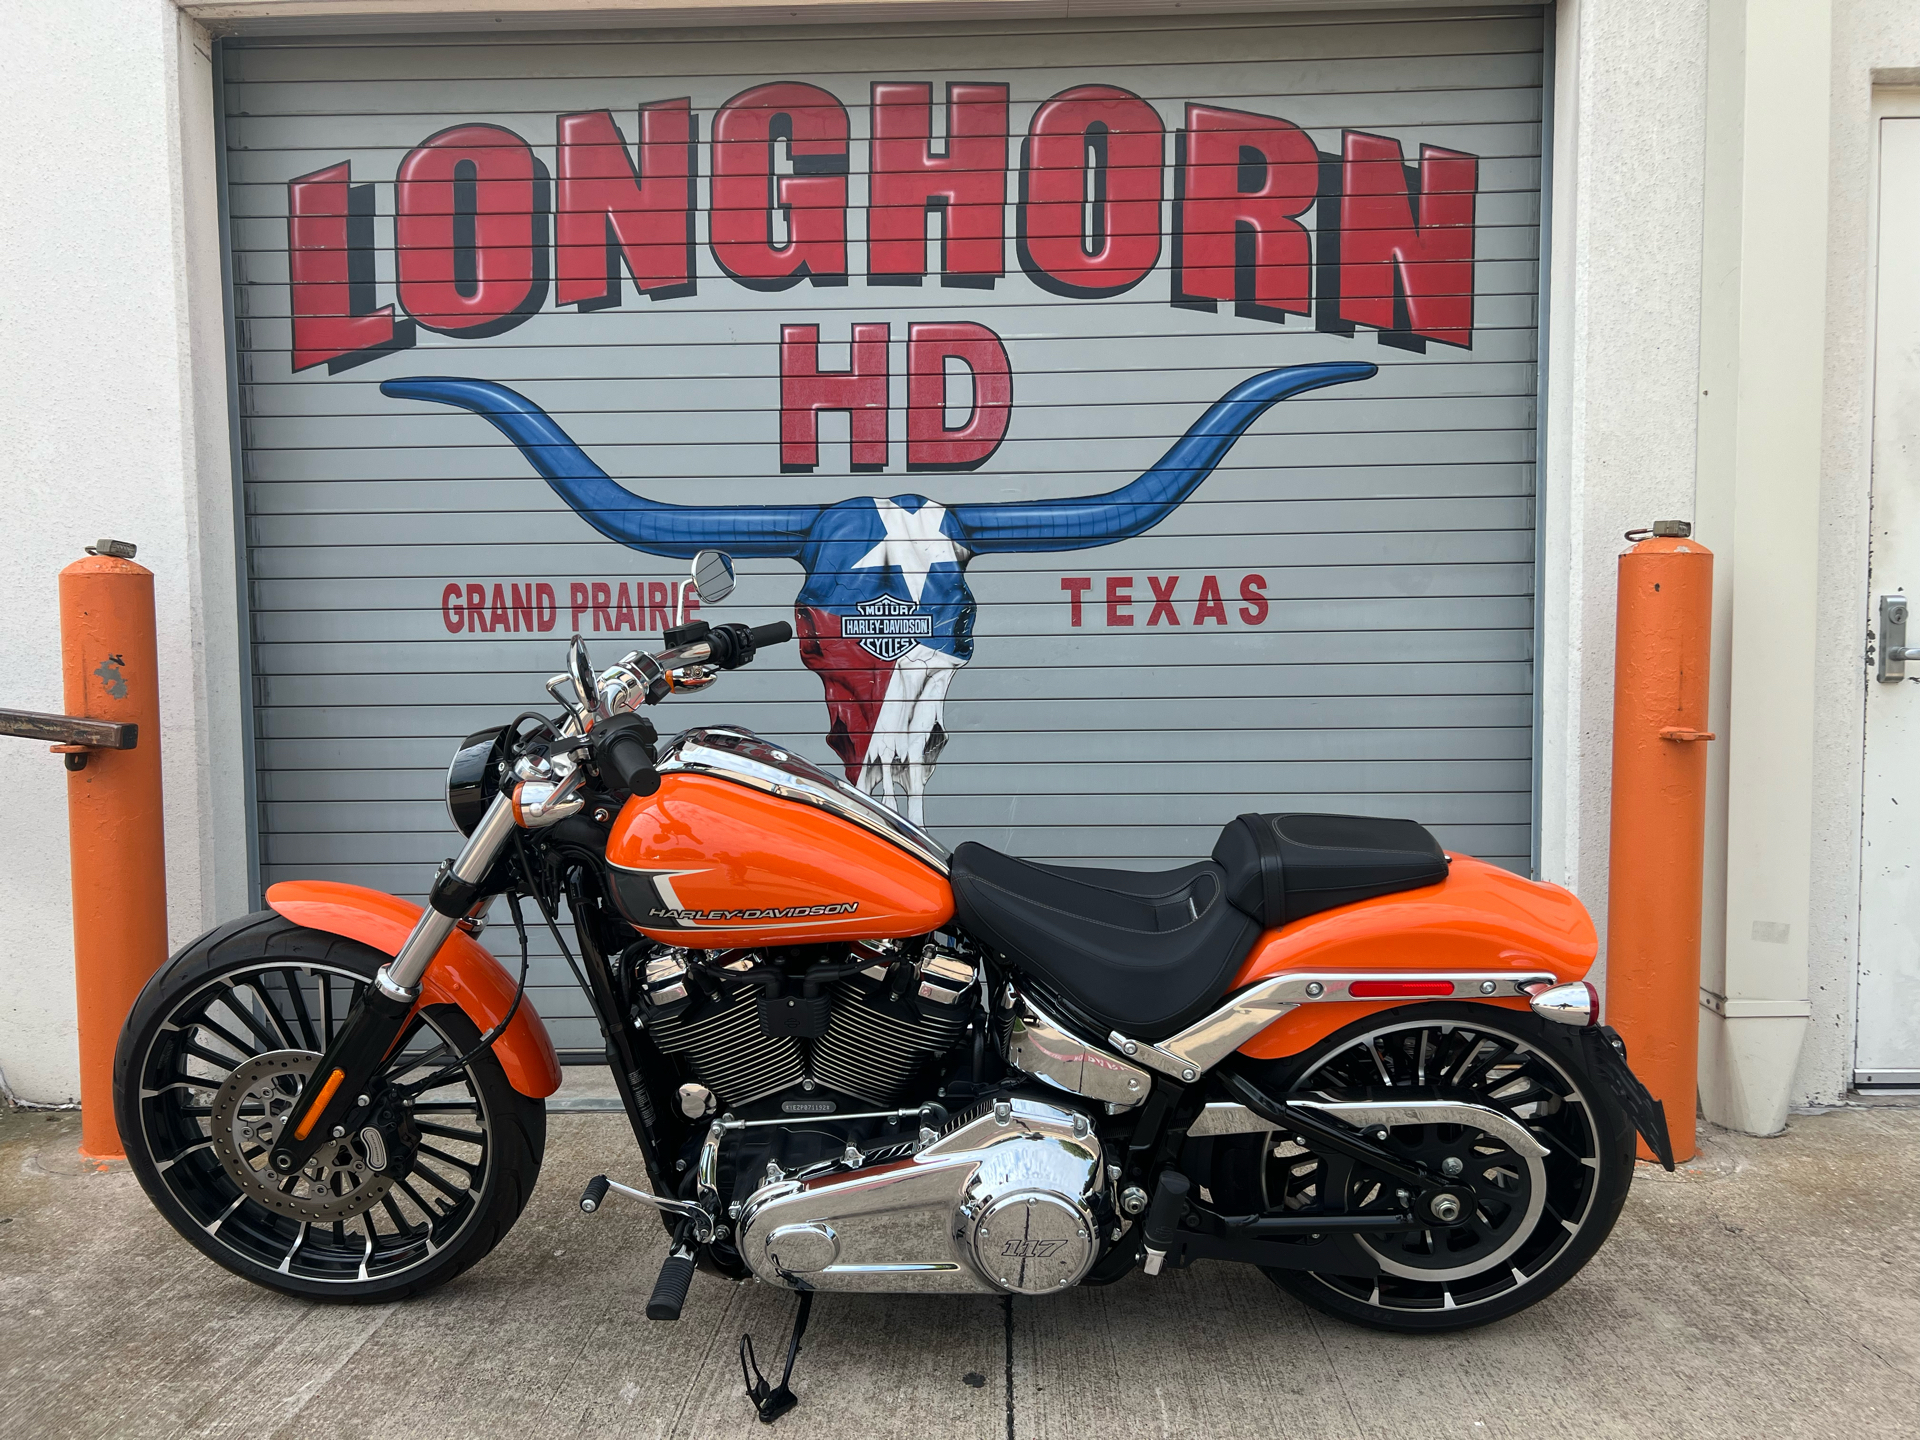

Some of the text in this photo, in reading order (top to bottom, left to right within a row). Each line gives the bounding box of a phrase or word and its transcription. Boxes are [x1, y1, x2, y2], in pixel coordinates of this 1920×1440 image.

[289, 81, 1480, 375] LONGHORN
[780, 322, 1013, 473] HD
[441, 581, 702, 634] GRAND PRAIRIE
[865, 600, 909, 616] MOTOR
[1060, 573, 1270, 627] TEXAS
[846, 619, 928, 635] HARLEY-DAVIDSON
[865, 638, 910, 658] CYCLES
[648, 901, 859, 921] HARLEY-DAVIDSON
[1001, 1239, 1069, 1258] 117
